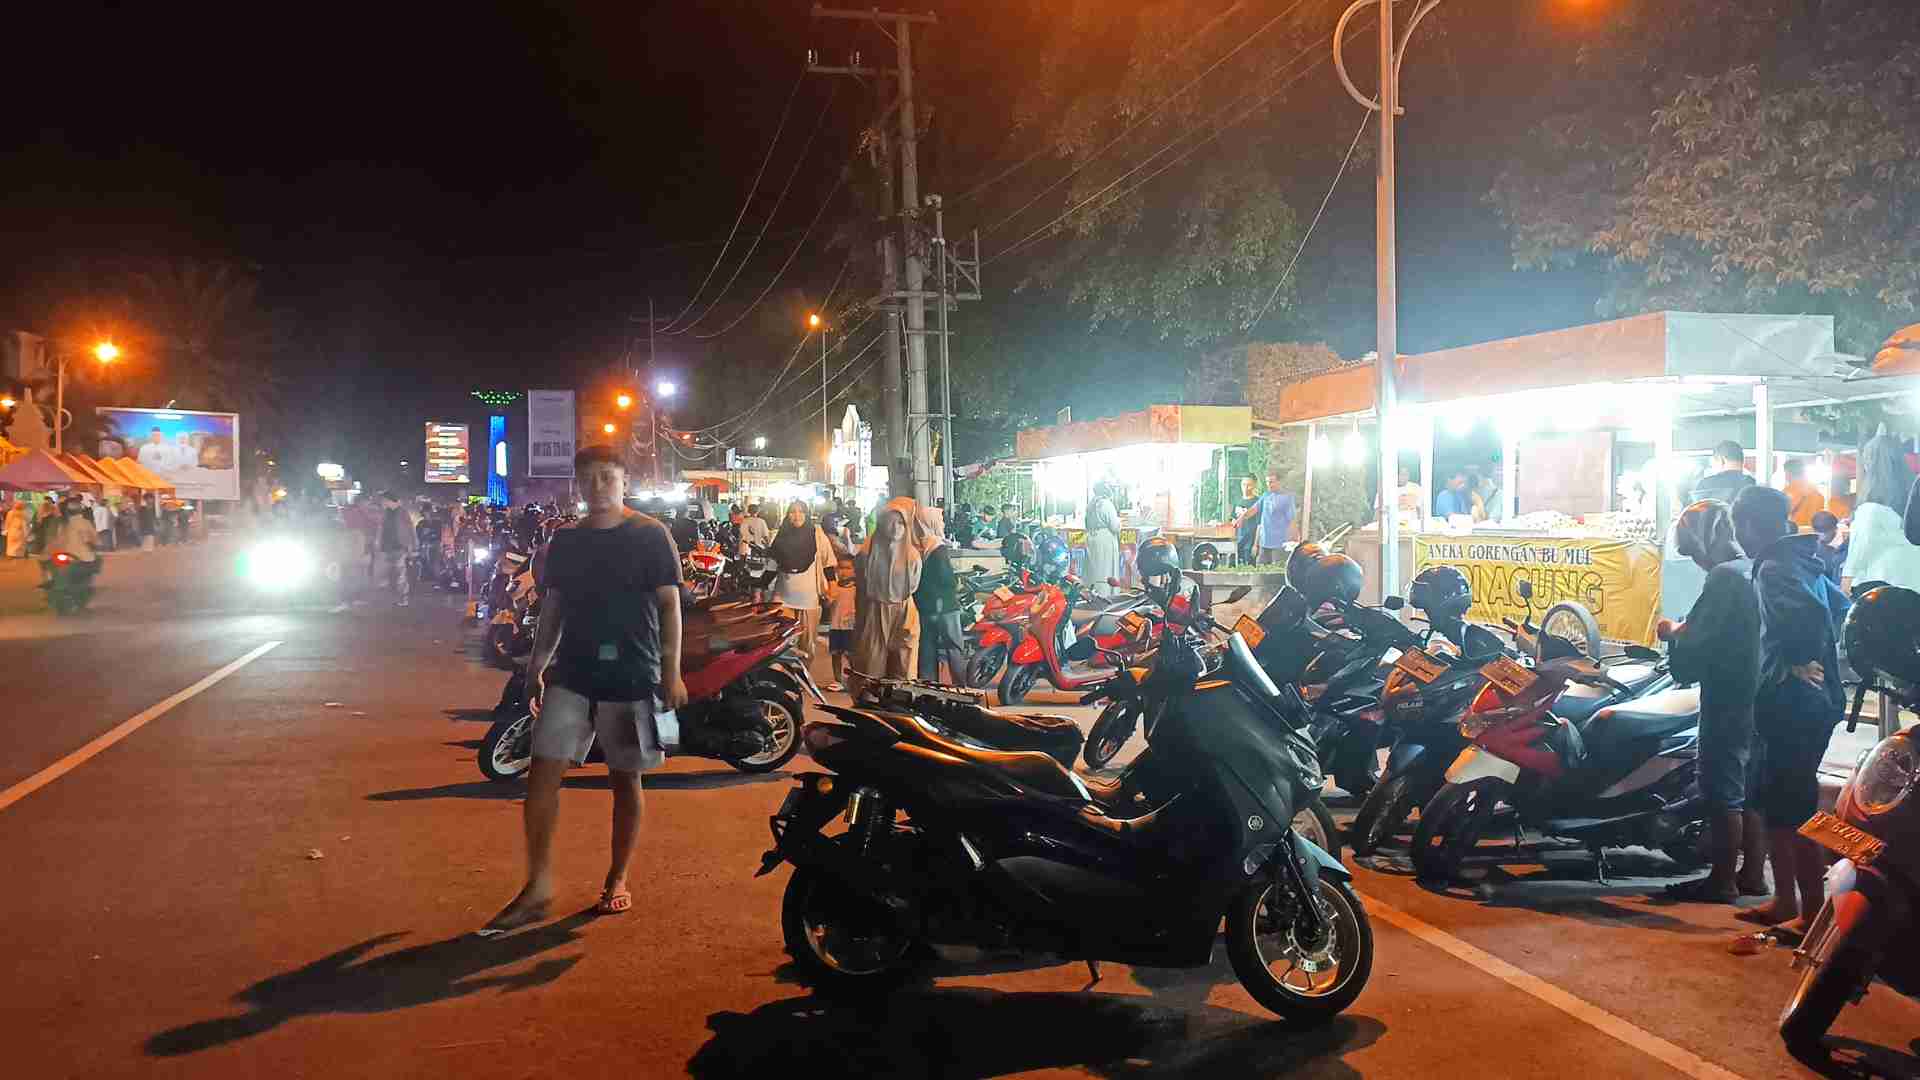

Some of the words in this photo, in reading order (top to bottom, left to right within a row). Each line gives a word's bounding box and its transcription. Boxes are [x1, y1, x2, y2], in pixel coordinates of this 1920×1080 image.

[1429, 543, 1463, 559] ANEKA
[1468, 544, 1537, 562] GORENGAN
[1542, 547, 1559, 563] BU
[1489, 565, 1604, 615] AGUNG
